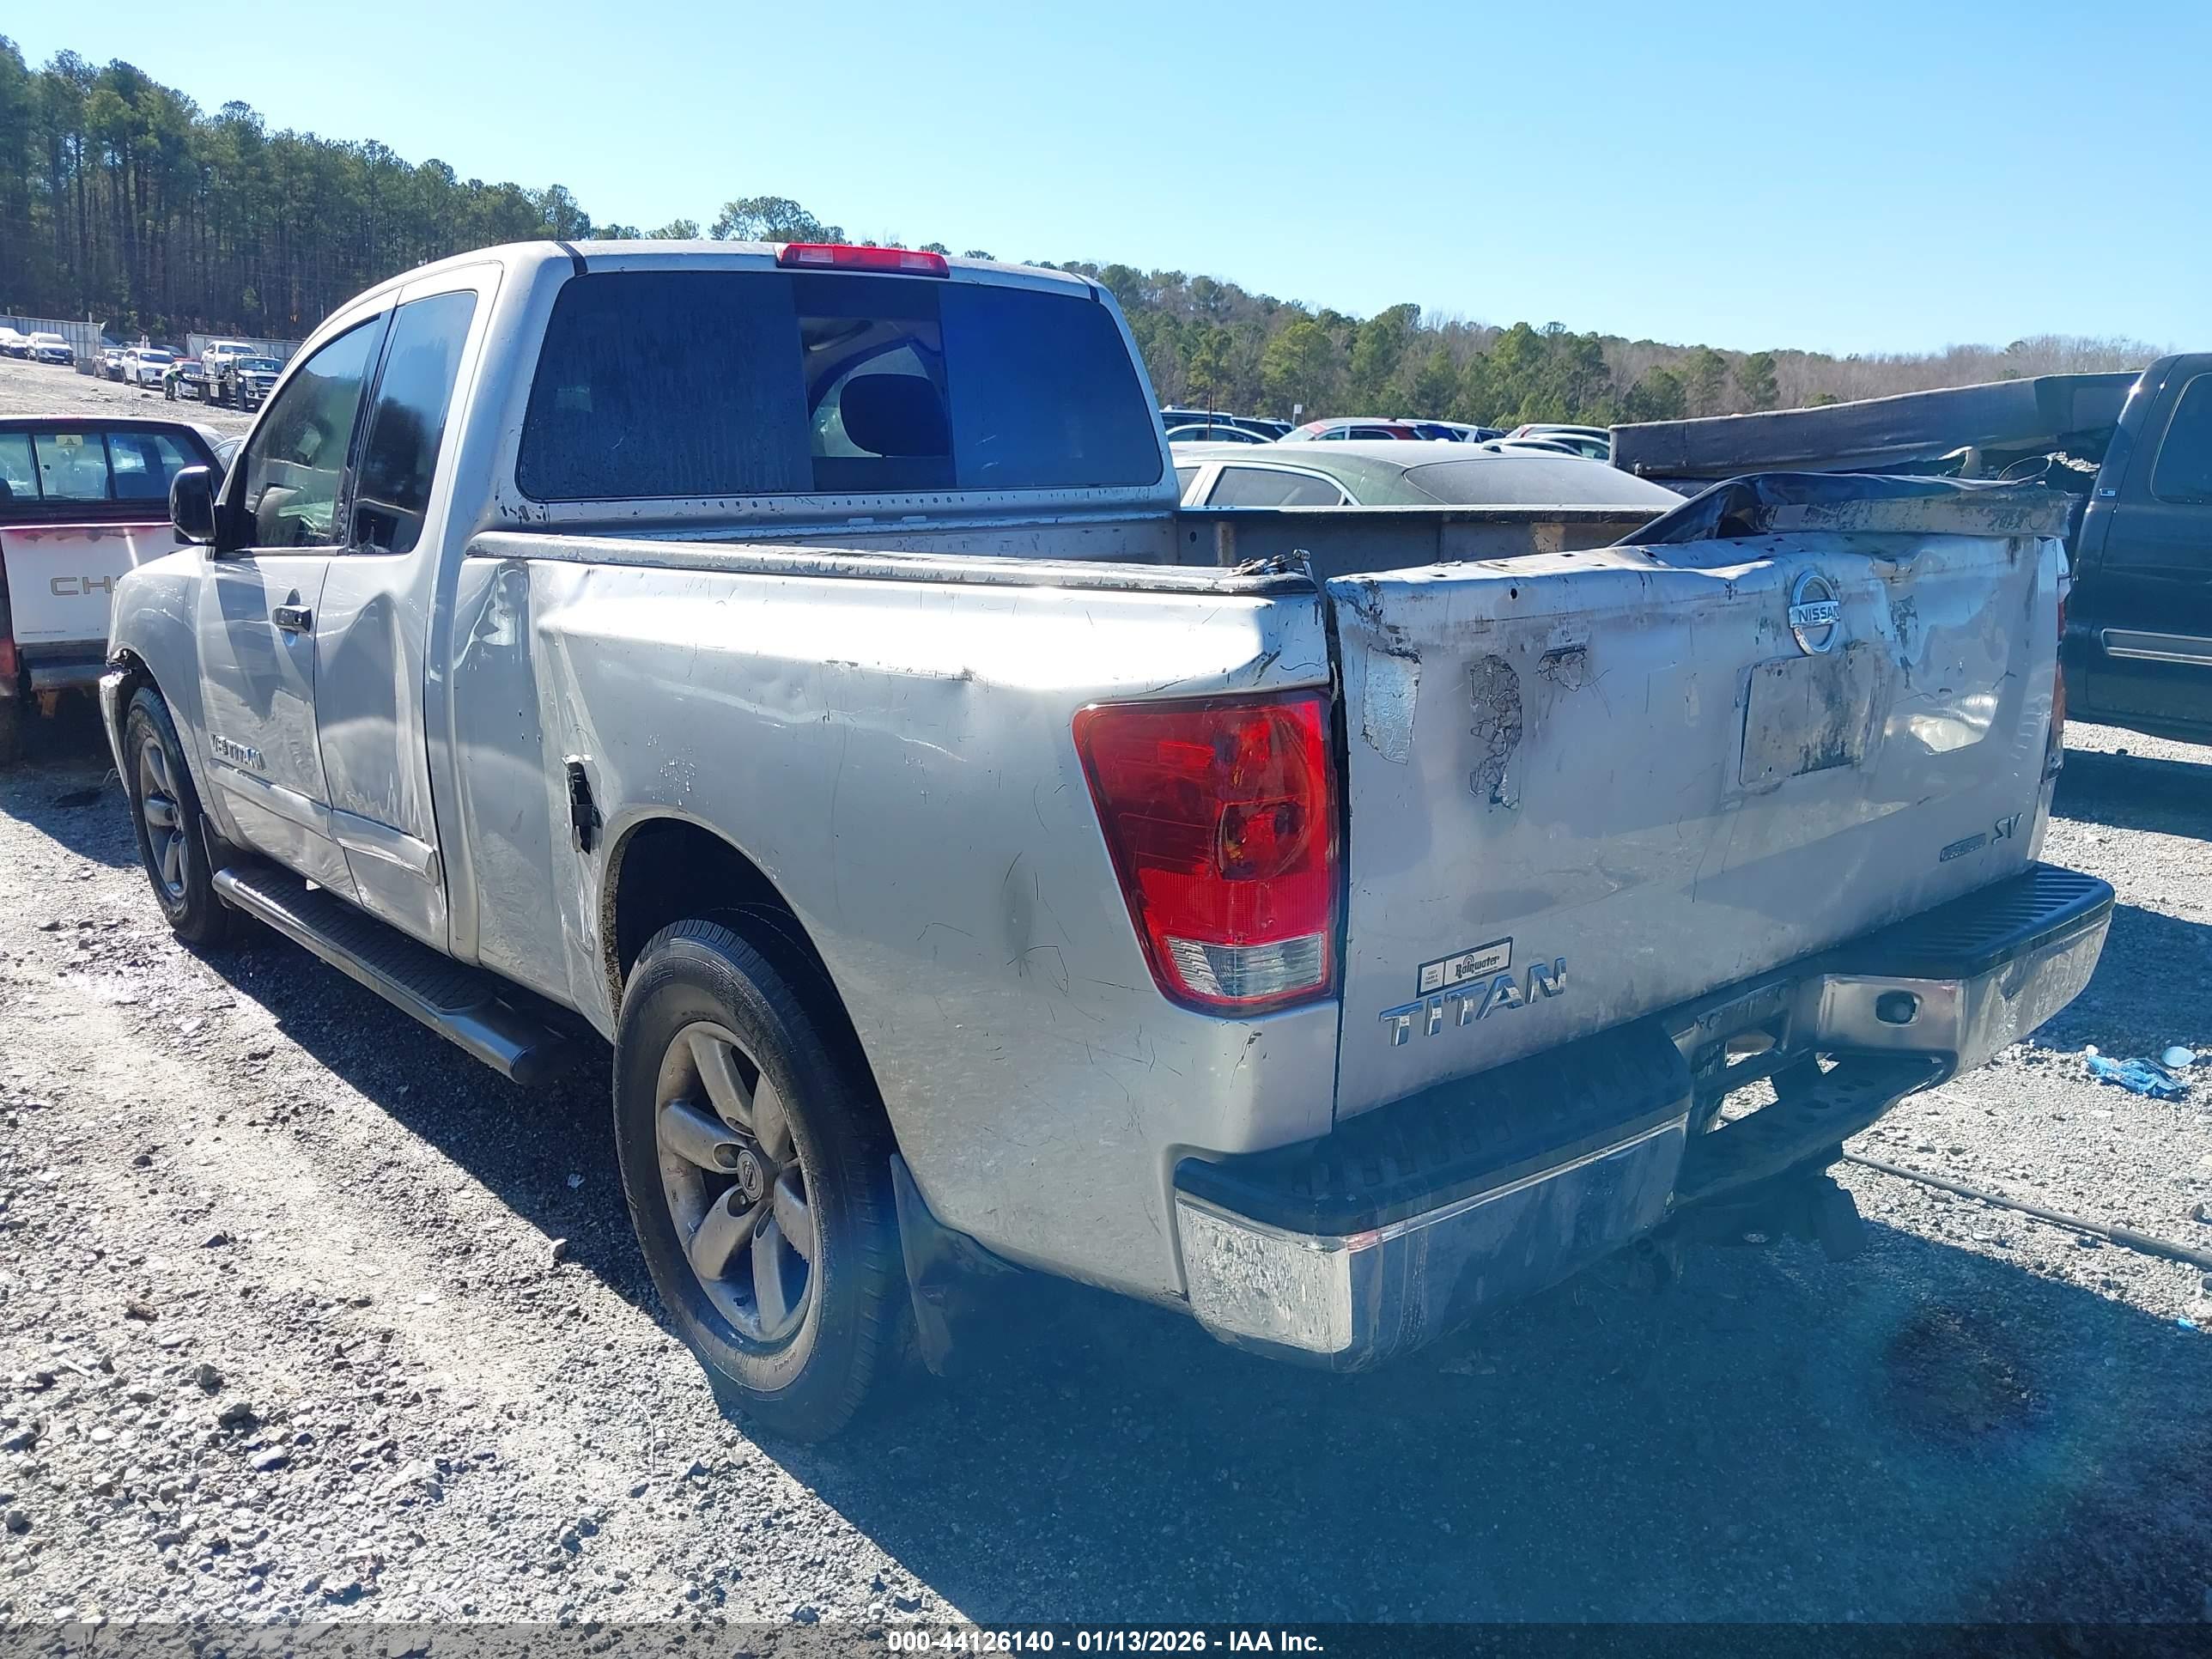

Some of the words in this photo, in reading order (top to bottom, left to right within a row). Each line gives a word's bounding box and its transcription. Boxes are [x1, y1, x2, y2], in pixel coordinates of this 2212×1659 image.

[50, 575, 121, 596] CH
[1798, 605, 1840, 622] NISSAN
[1991, 812, 2023, 846] SV
[1455, 955, 1500, 979] Rainwater
[1379, 957, 1567, 1047] TITAN
